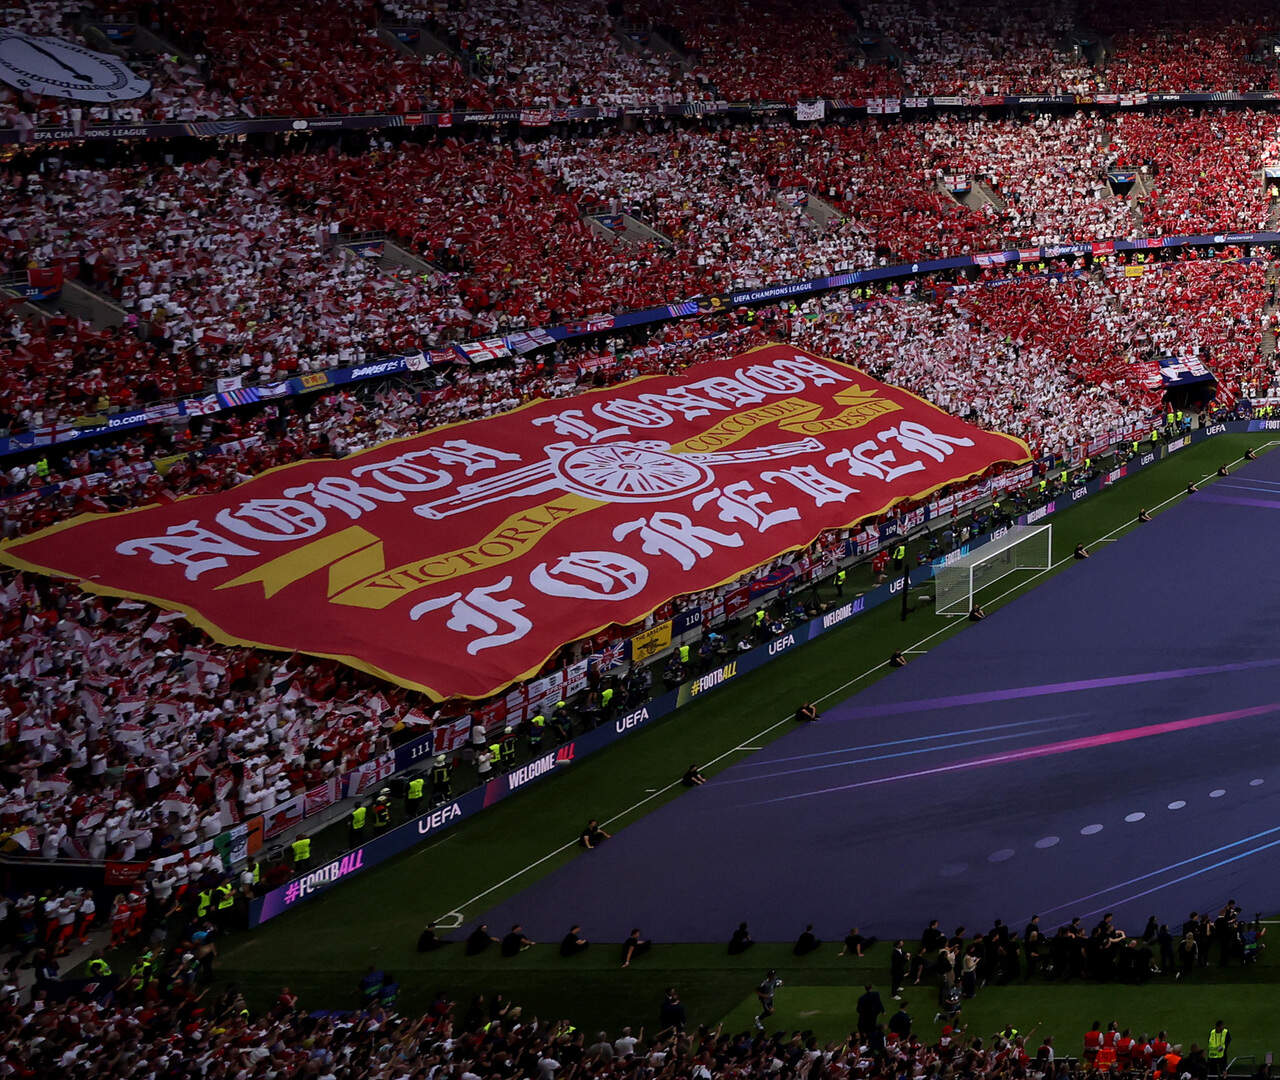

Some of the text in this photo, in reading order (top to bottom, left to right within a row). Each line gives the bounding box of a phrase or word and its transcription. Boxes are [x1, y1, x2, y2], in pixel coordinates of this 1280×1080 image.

[113, 127, 148, 137] LEAGUE
[733, 283, 812, 303] UEFA CHAMPIONS LEAGUE
[1206, 423, 1226, 435] UEFA
[115, 355, 851, 581] NORTH LONDON
[1141, 452, 1154, 466] UEFA
[365, 397, 893, 593] VICTORIA CONCORDIA CRESCIT
[1072, 486, 1088, 501] UEFA
[410, 420, 975, 655] FOREVER
[885, 526, 897, 535] 109
[991, 526, 1009, 542] UEFA
[685, 613, 700, 626] 110
[823, 597, 865, 628] WELCOME ALL
[768, 632, 795, 656] UEFA
[690, 661, 737, 697] #FOOTBALL
[615, 708, 650, 734] UEFA
[411, 741, 431, 758] 111
[508, 742, 576, 792] WELCOME ALL
[417, 803, 462, 835] UEFA
[284, 850, 365, 904] #FOOTBALL
